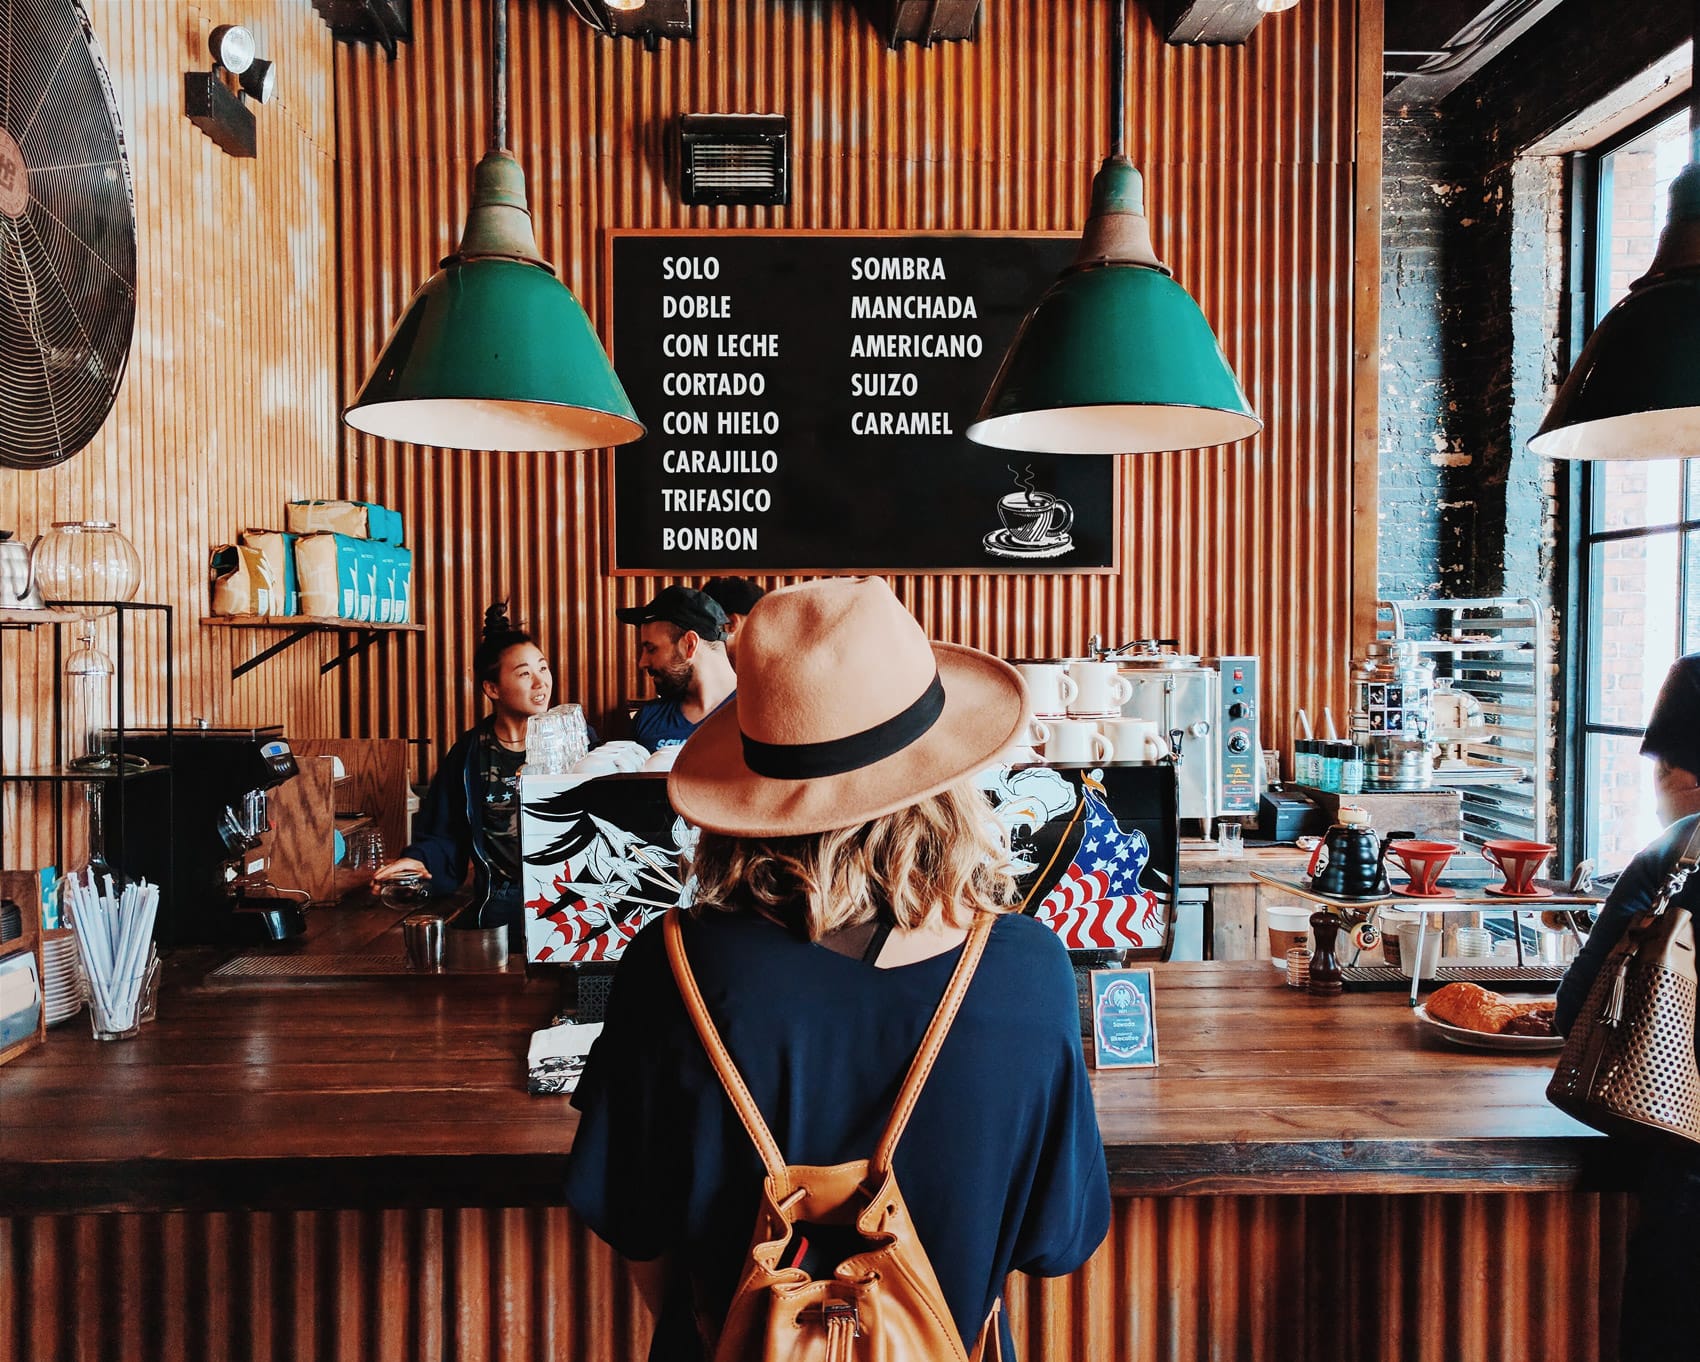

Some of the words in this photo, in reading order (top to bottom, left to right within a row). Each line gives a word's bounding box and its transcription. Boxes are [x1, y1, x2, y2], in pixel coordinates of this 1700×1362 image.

[662, 256, 720, 280] SOLO
[851, 256, 946, 281] SOMBRA
[663, 295, 731, 319] DOBLE
[850, 295, 978, 319] MANCHADA
[662, 333, 708, 358] CON
[717, 333, 779, 358] LECHE
[850, 334, 983, 358] AMERICANO
[662, 372, 765, 396] CORTADO
[851, 372, 918, 397] SUIZO
[662, 411, 708, 435] CON
[717, 411, 780, 435] HIELO
[851, 411, 953, 436] CARAMEL
[662, 449, 778, 474] CARAJILLO
[661, 488, 771, 513] TRIFASICO
[663, 527, 758, 551] BONBON
